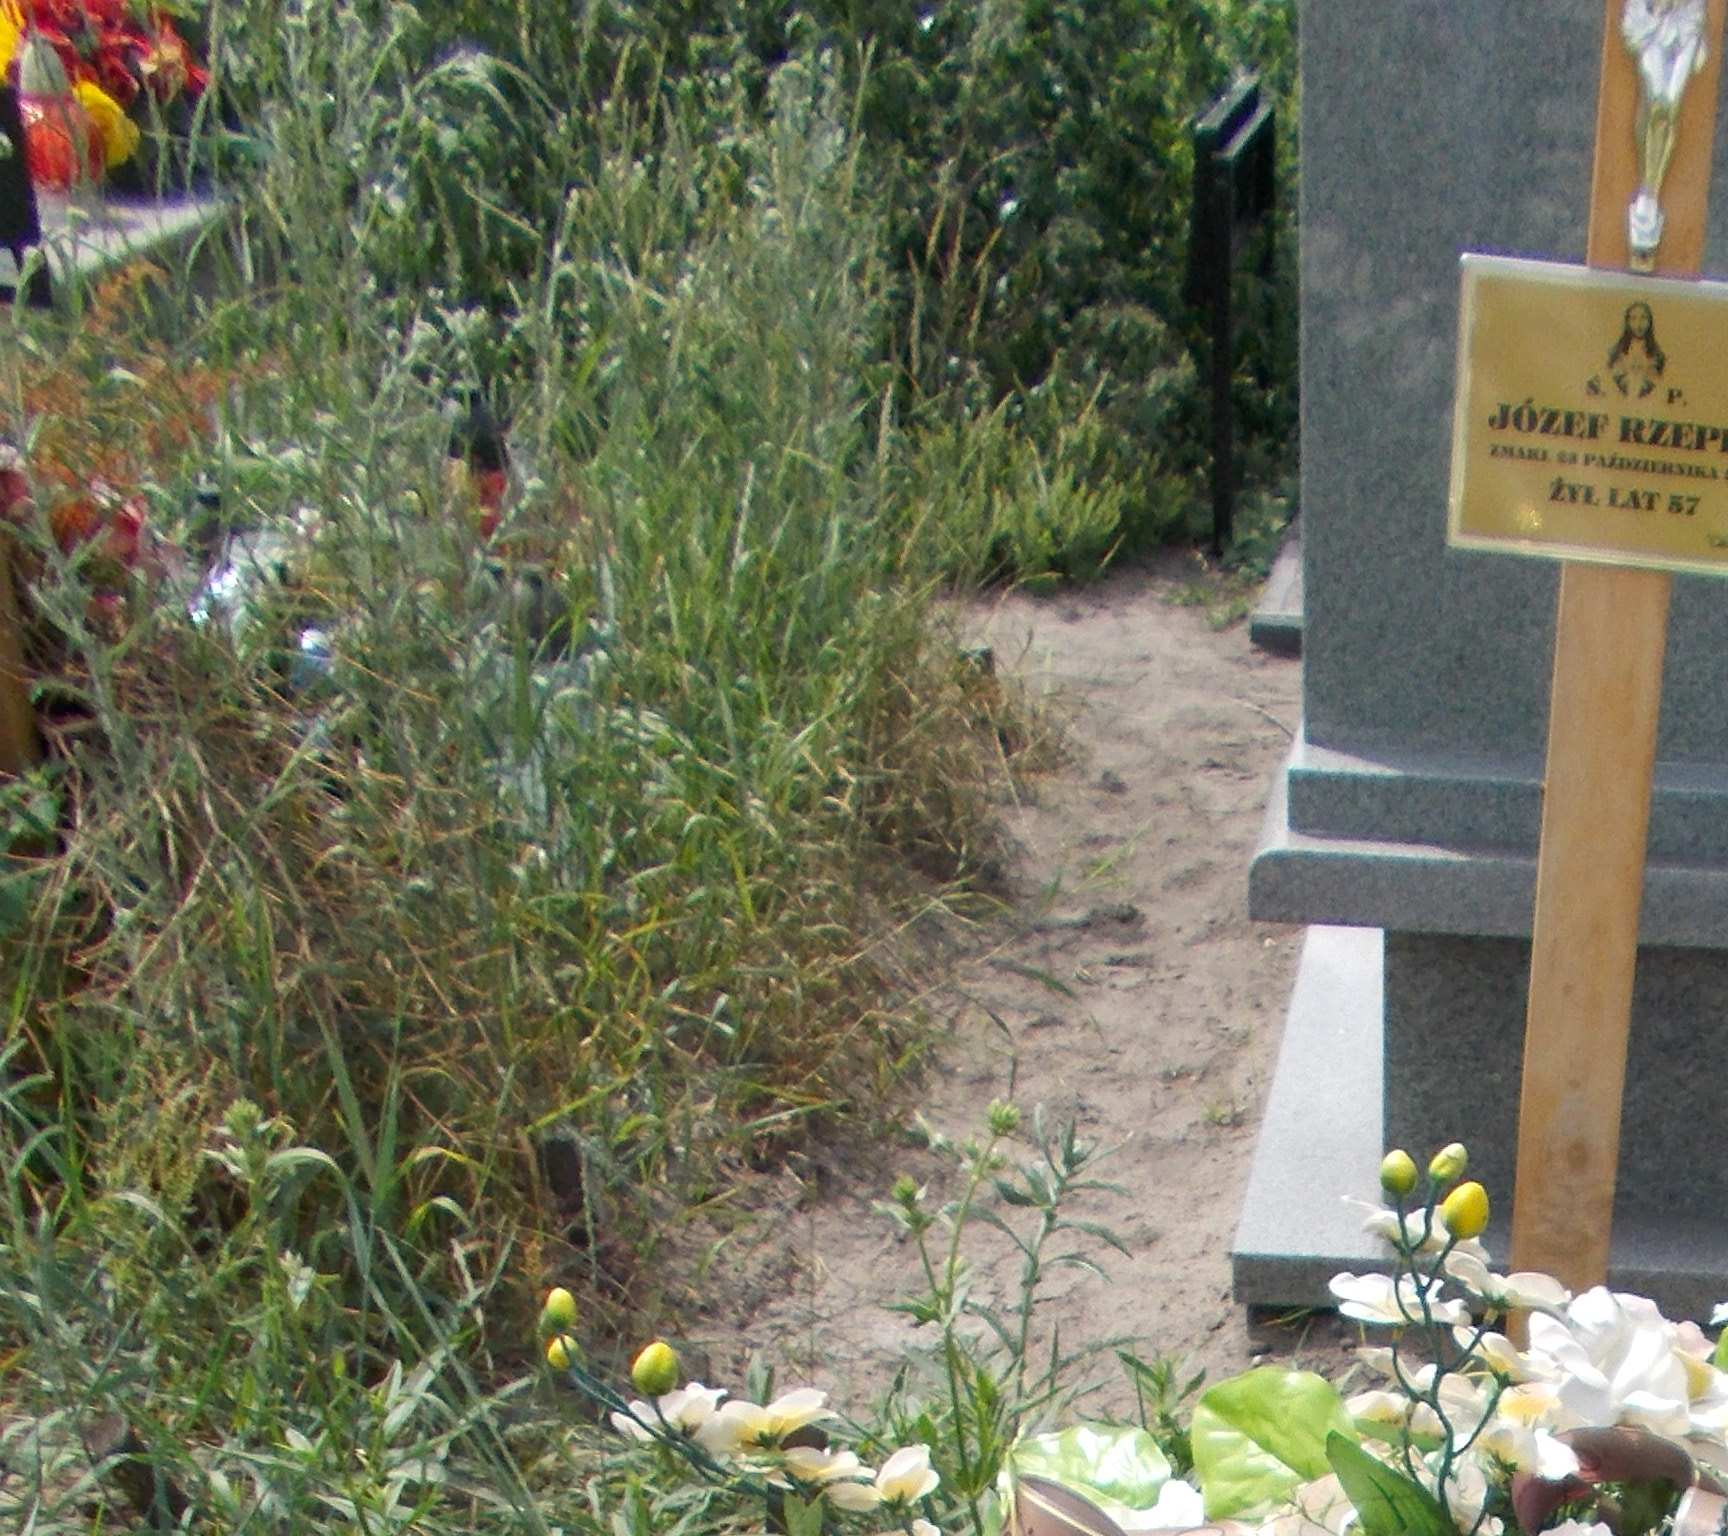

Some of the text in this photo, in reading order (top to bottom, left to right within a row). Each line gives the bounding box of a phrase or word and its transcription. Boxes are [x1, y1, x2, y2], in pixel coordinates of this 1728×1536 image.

[1487, 397, 1609, 440] JÓZEF
[1608, 486, 1661, 511] LAT
[1667, 492, 1701, 515] 57
